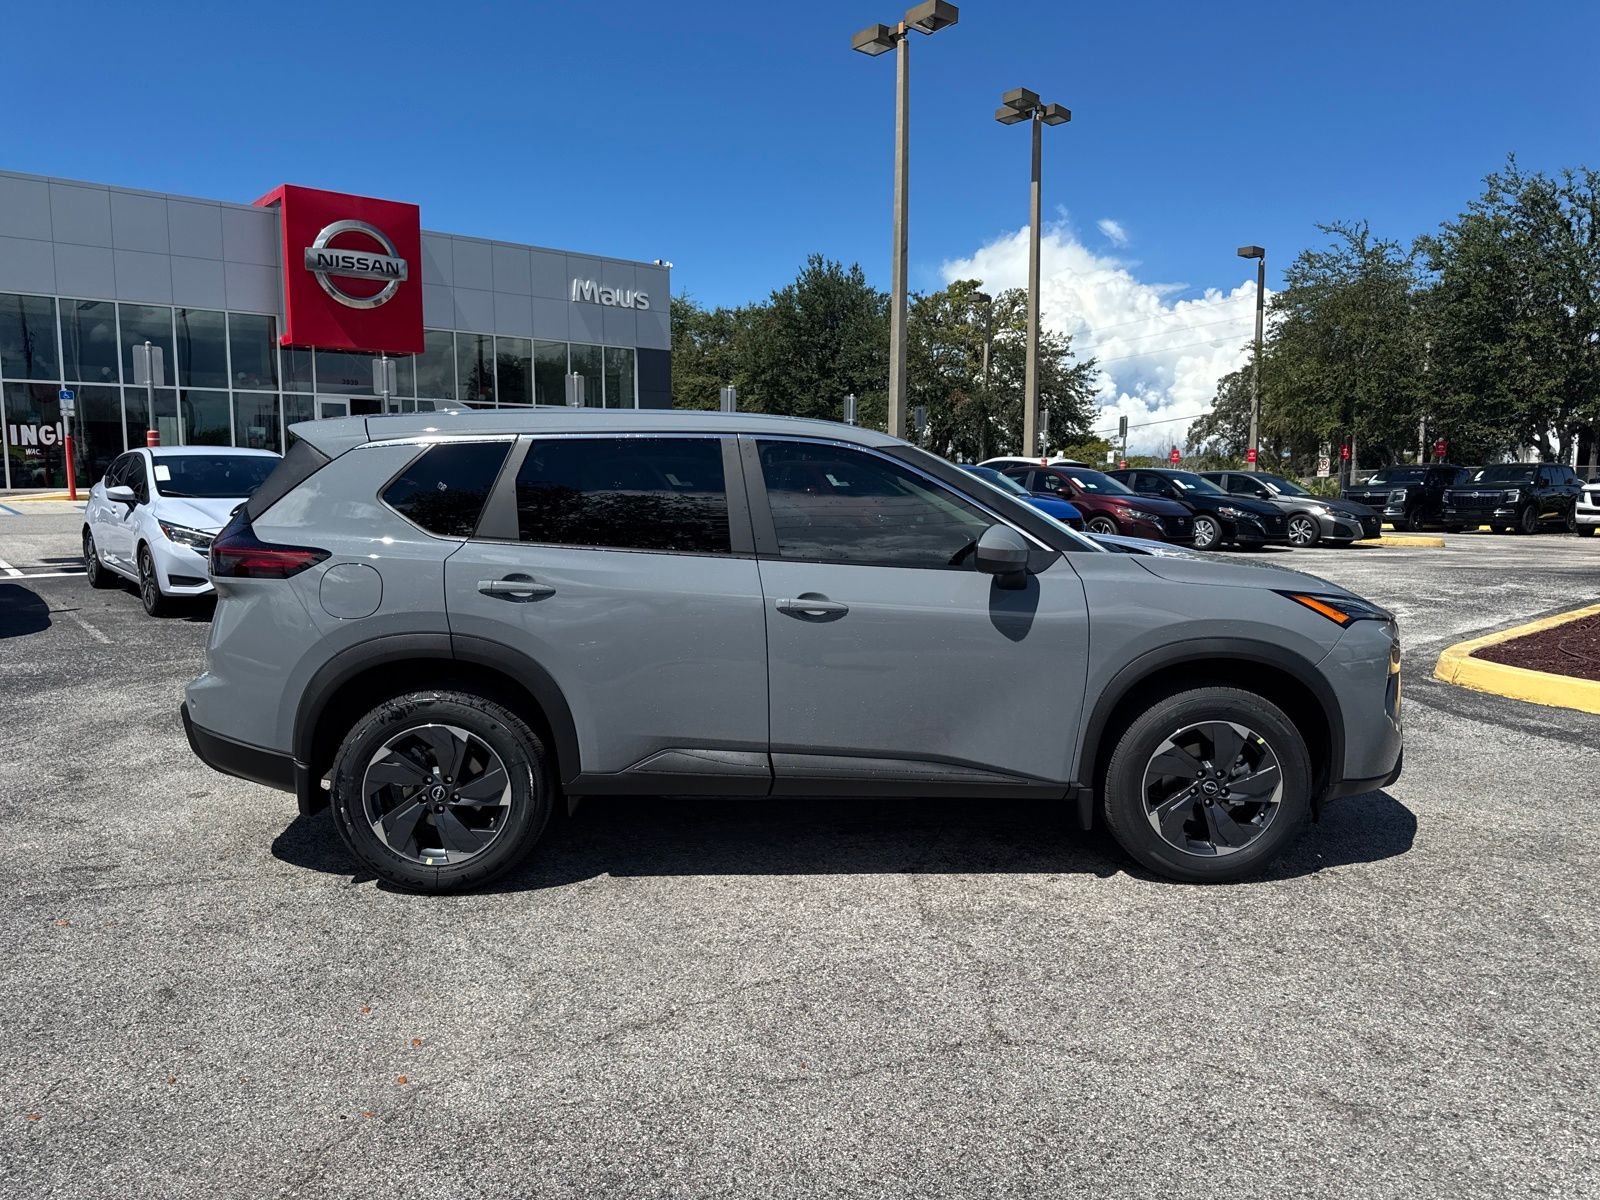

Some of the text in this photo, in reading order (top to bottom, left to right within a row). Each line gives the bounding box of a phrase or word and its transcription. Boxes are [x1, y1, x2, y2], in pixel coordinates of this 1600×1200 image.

[317, 253, 399, 275] NISSAN
[572, 278, 650, 310] Maus
[0, 421, 63, 446] ING!
